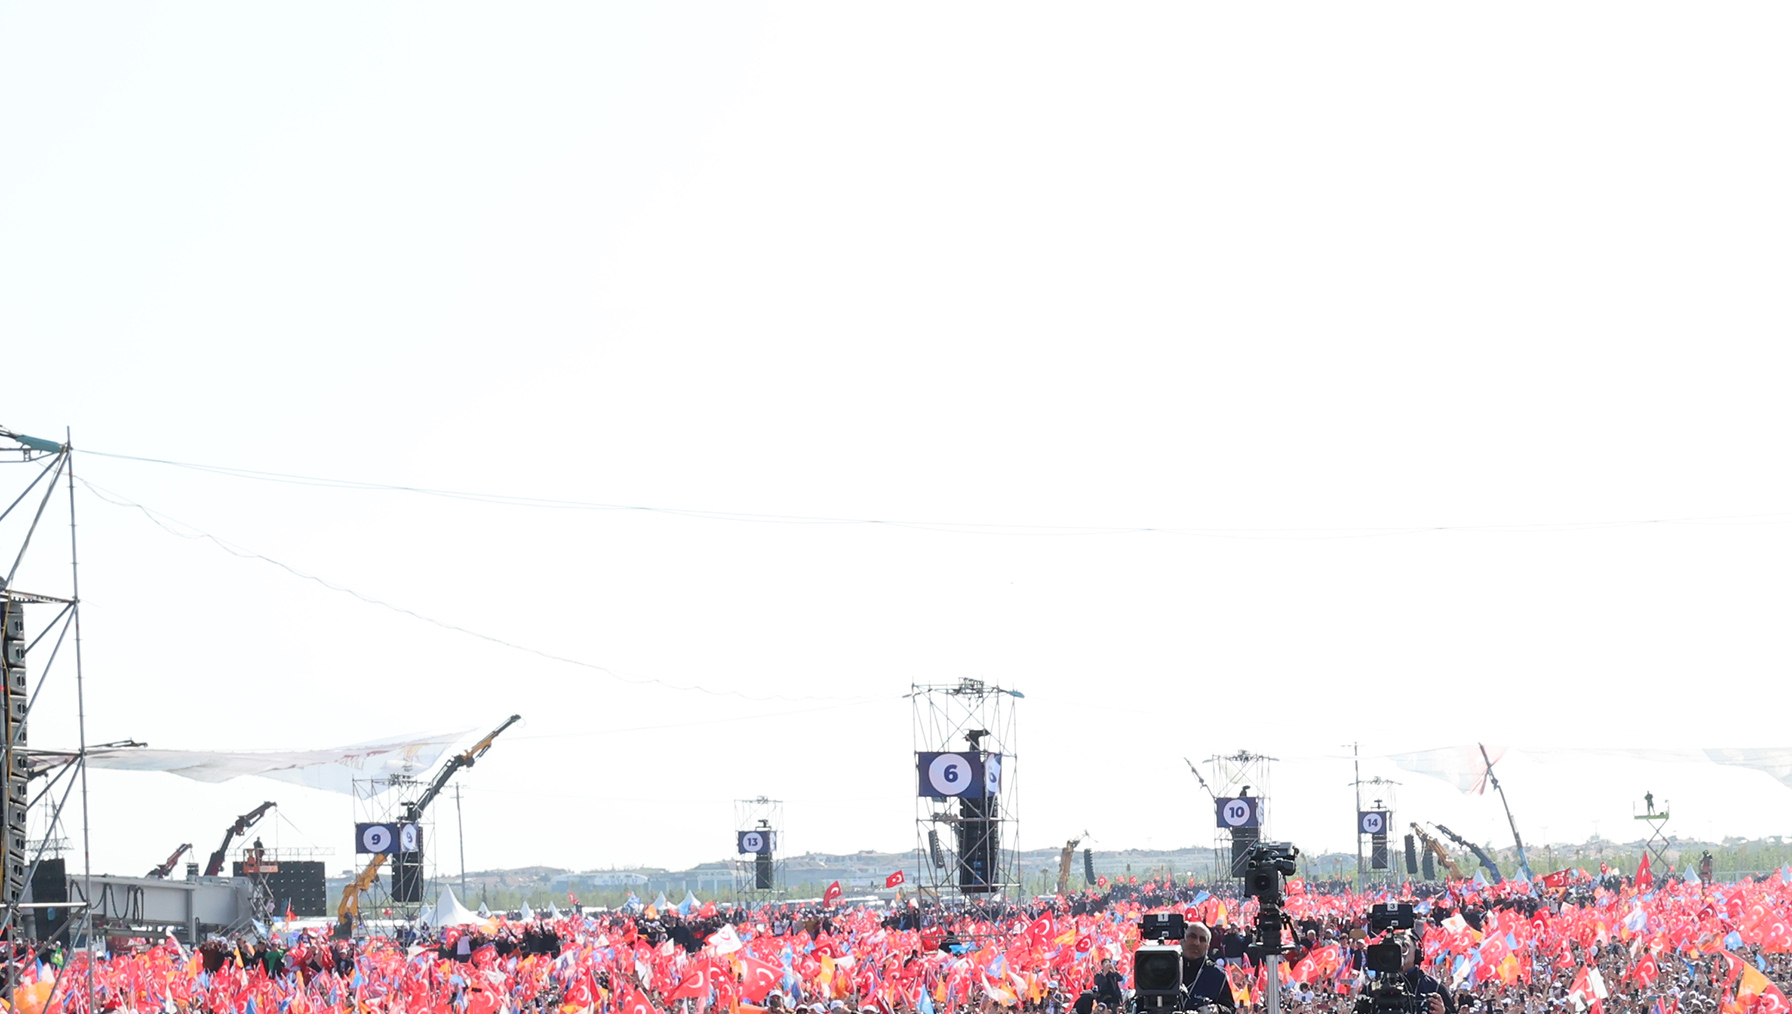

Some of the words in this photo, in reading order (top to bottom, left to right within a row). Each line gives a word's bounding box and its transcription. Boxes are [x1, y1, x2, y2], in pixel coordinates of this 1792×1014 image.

[944, 765, 958, 783] 6
[1229, 806, 1245, 819] 10
[1366, 817, 1379, 825] 14
[372, 834, 381, 846] 9
[747, 837, 759, 847] 13
